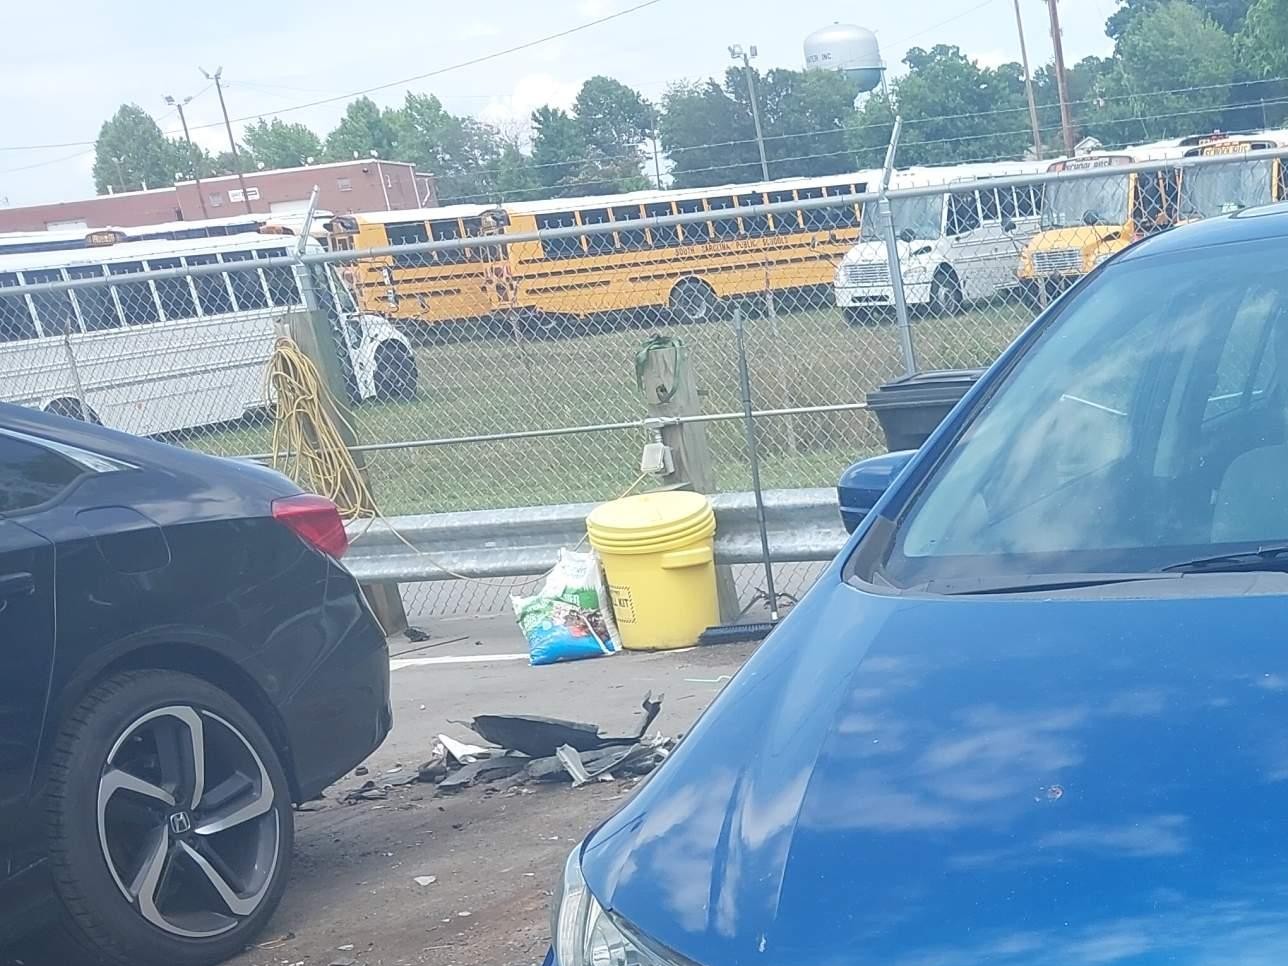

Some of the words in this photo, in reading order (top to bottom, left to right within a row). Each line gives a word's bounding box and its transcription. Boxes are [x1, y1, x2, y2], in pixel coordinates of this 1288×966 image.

[675, 246, 695, 256] SOUTH
[701, 242, 730, 253] CAROLINA
[735, 239, 757, 249] PUBLIC
